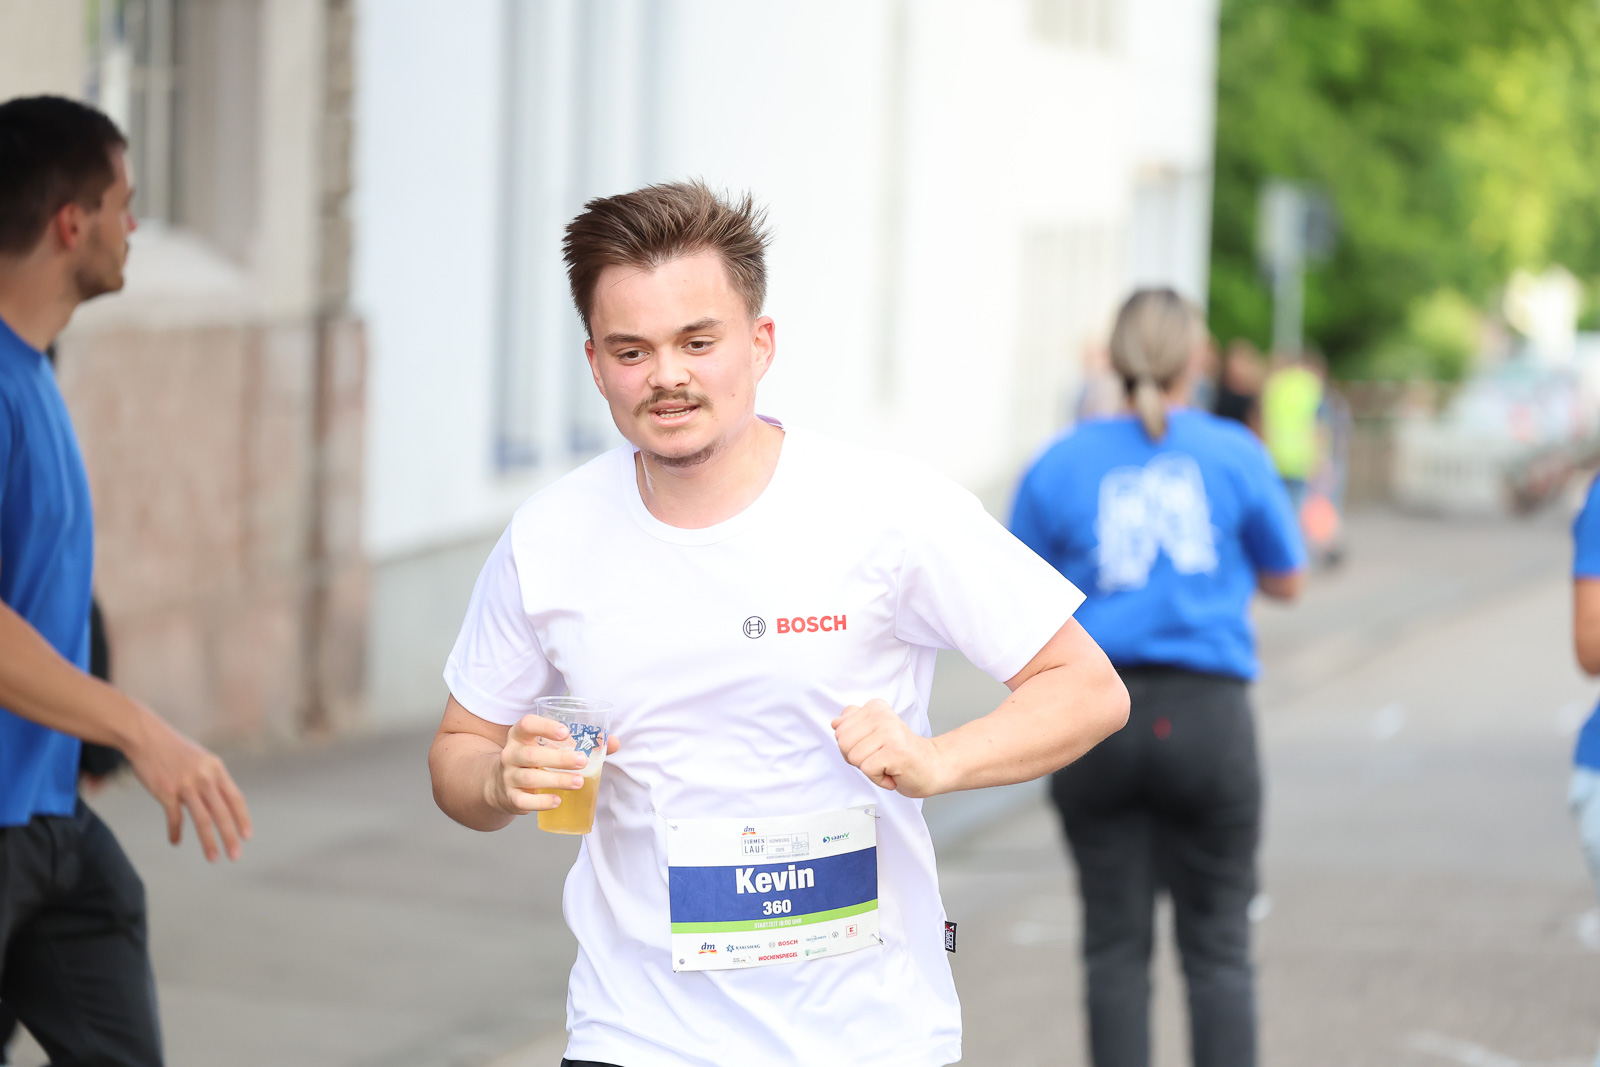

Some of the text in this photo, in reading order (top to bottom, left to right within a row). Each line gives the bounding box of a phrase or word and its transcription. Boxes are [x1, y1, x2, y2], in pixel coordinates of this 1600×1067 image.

[776, 614, 847, 634] BOSCH
[744, 845, 765, 854] LAUF
[735, 864, 815, 895] Kevin
[762, 899, 792, 916] 360
[754, 921, 778, 929] STARTZEIT
[701, 942, 716, 950] dm
[777, 939, 799, 947] BOSCH
[758, 952, 798, 961] WOCHENSPIEGEL
